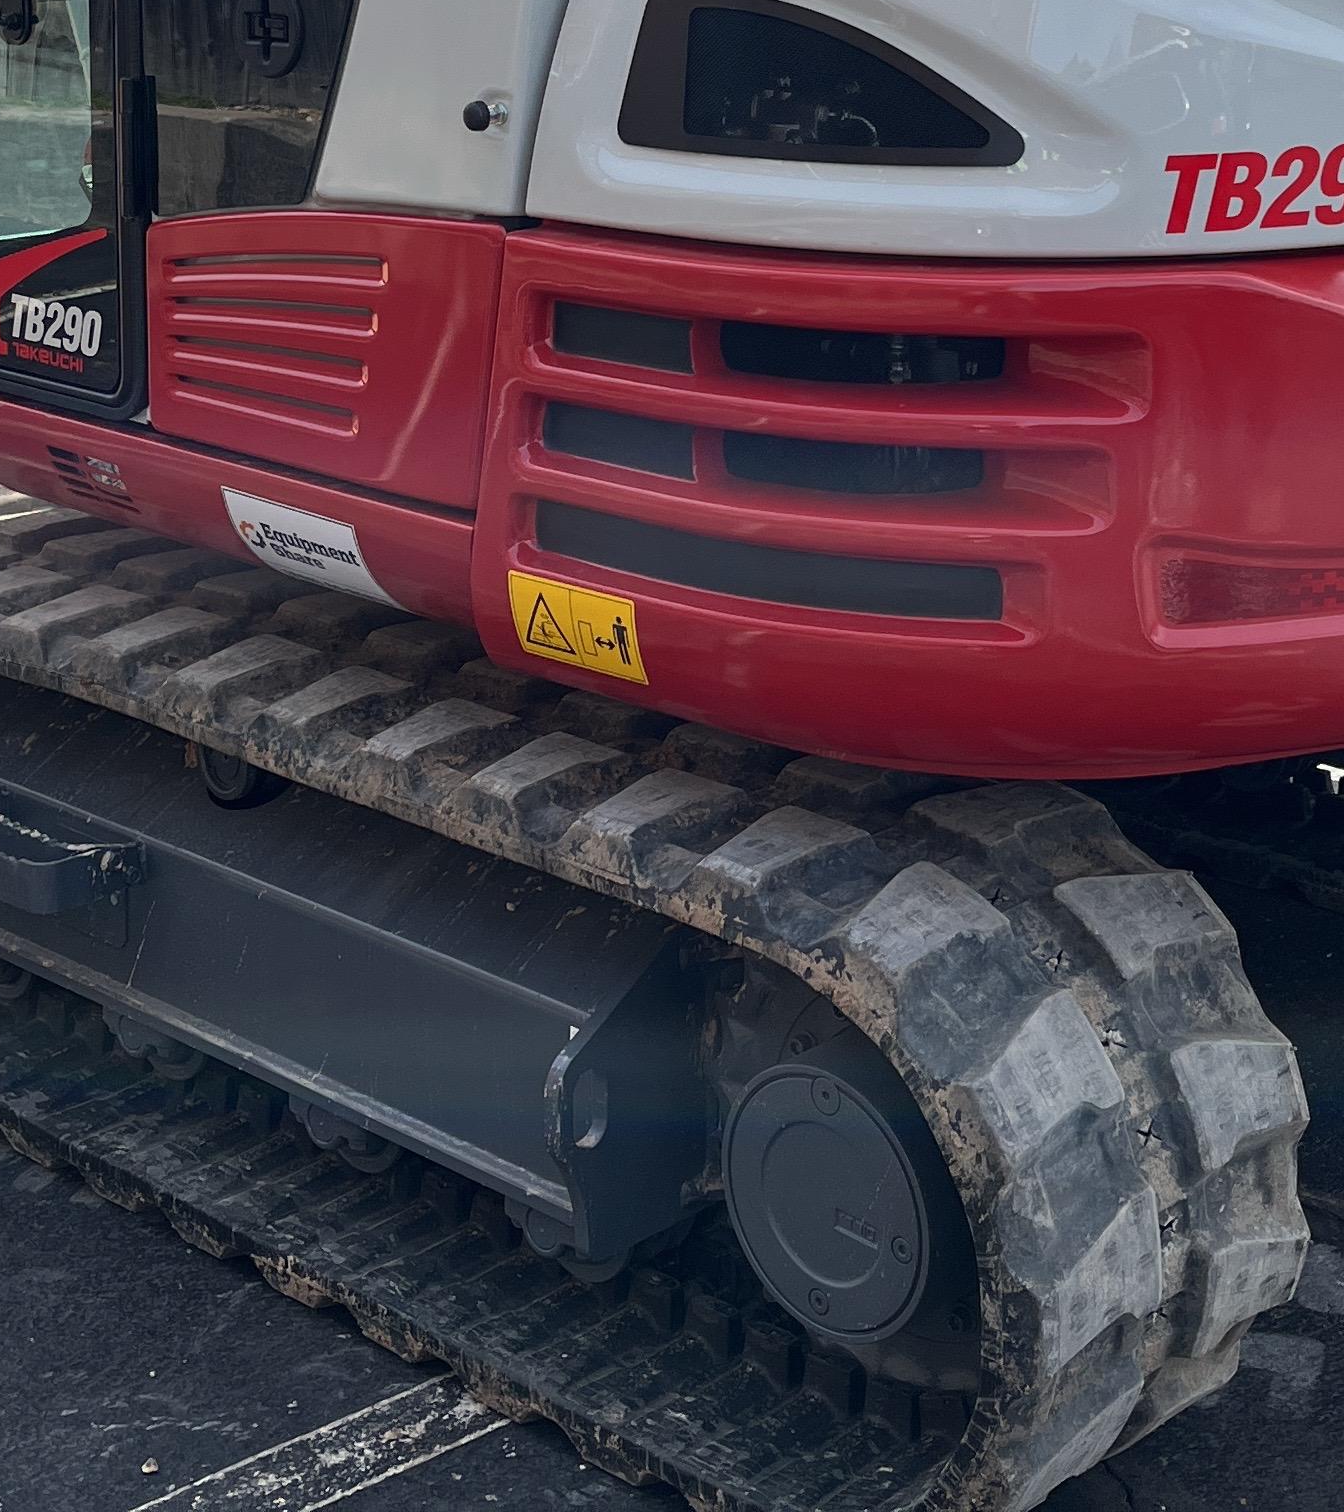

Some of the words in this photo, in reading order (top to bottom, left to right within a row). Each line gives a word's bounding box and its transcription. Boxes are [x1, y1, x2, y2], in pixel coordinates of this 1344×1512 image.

[11, 293, 102, 357] TB290
[12, 342, 84, 373] TAKEUCHI
[259, 522, 360, 567] Equipment
[269, 542, 327, 569] Share
